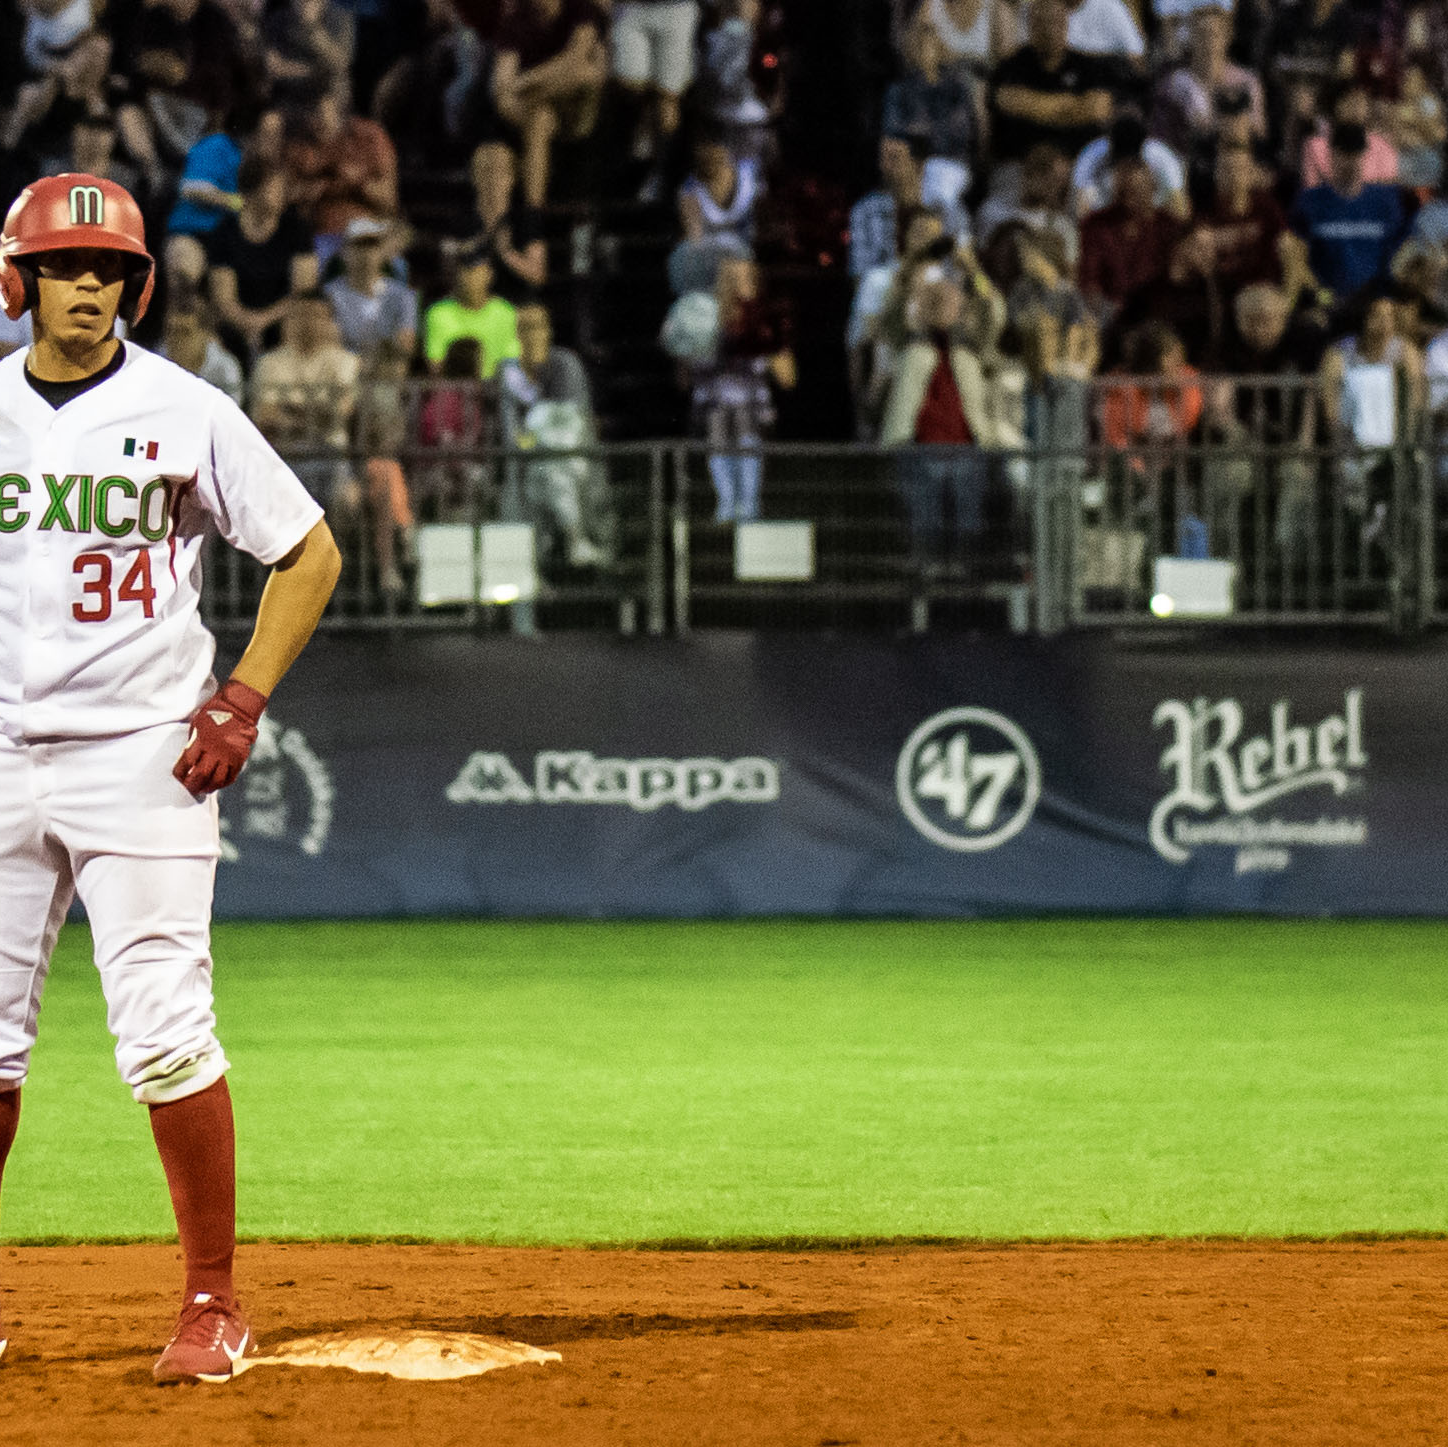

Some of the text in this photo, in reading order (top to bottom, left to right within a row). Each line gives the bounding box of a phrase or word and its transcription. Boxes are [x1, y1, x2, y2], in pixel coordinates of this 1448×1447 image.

[72, 548, 156, 622] 34
[538, 752, 779, 811] Kappa
[1151, 689, 1368, 814] Rebel
